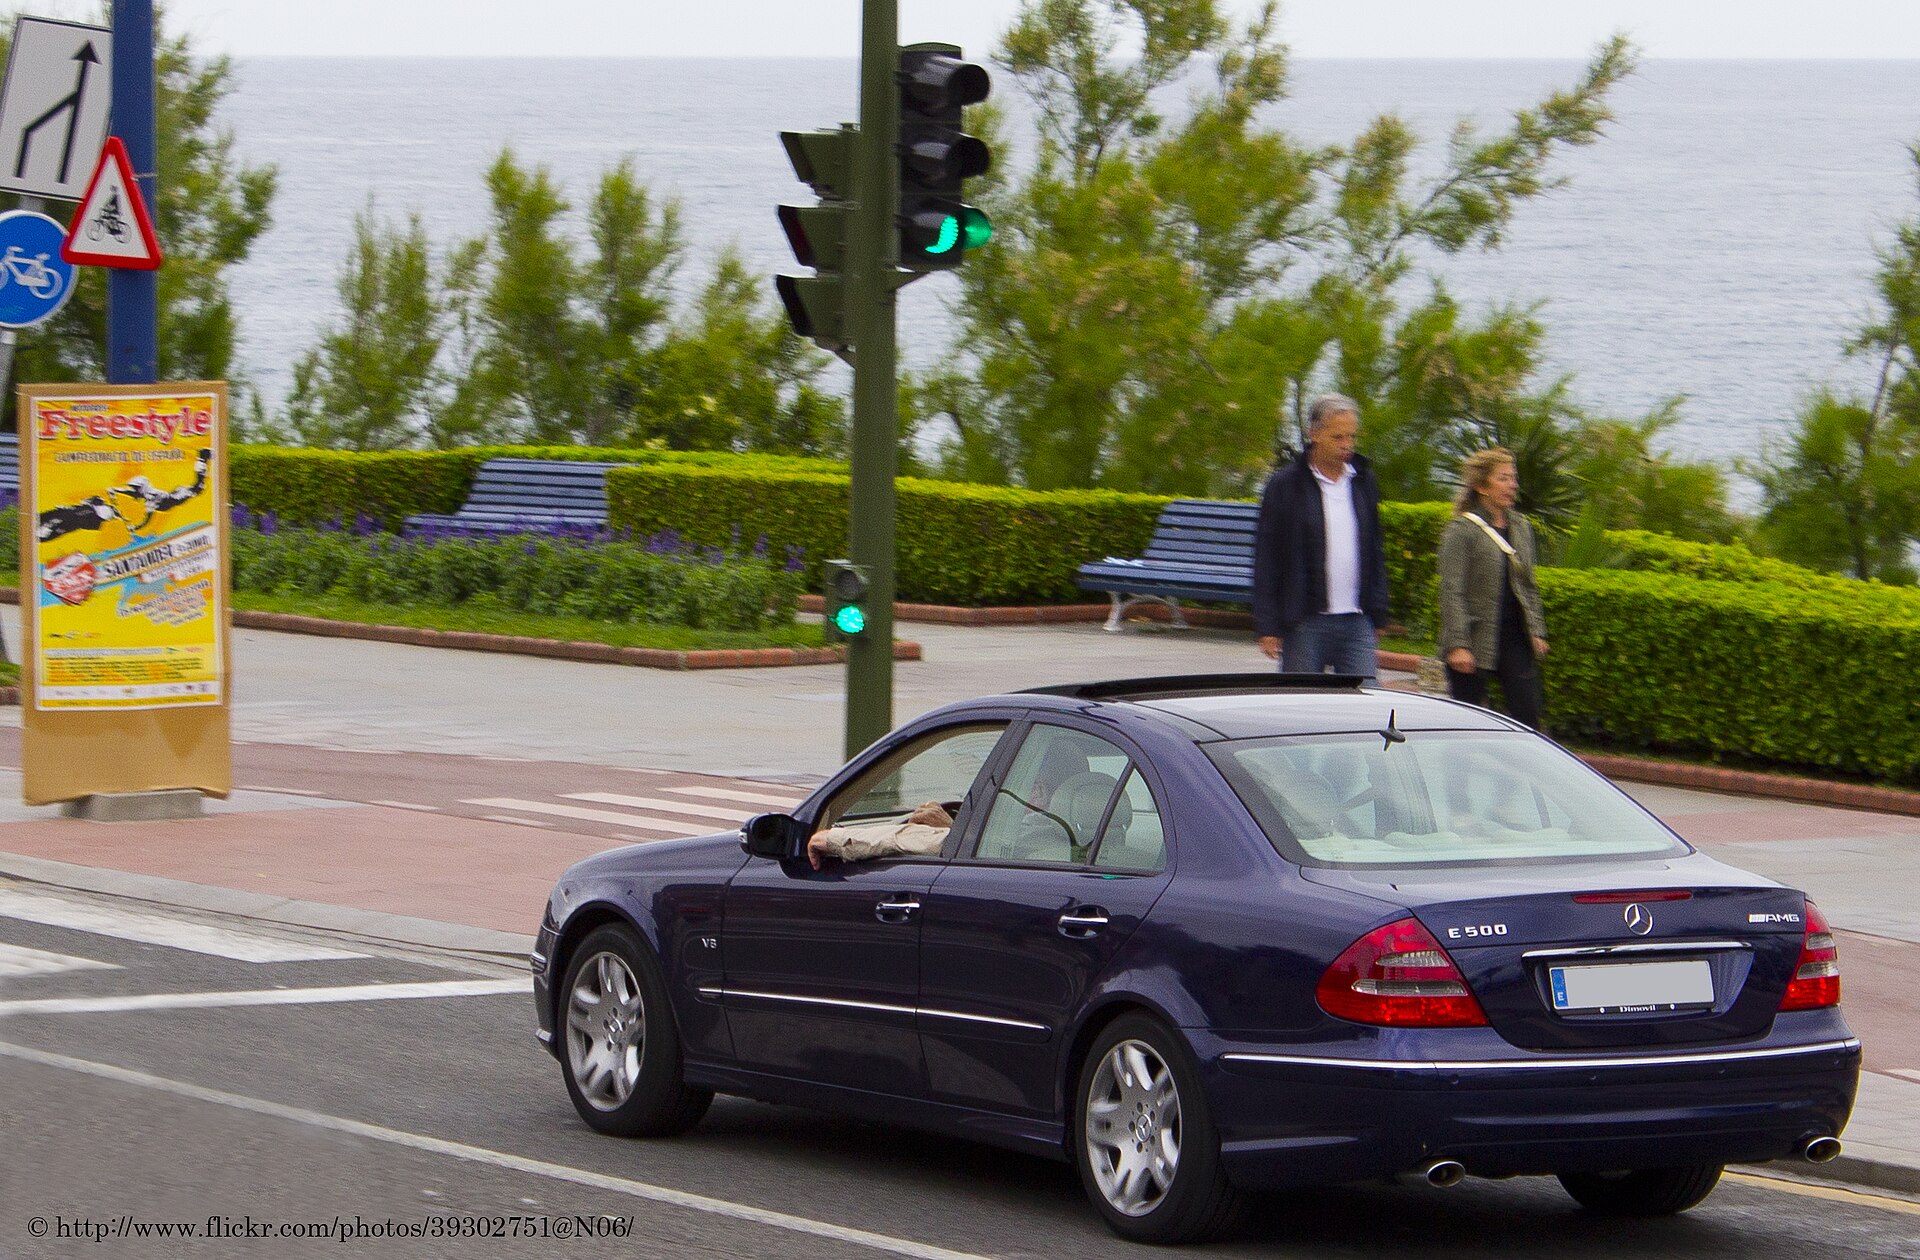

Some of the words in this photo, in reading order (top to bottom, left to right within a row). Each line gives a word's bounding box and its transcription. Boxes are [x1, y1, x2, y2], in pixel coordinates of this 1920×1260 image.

[38, 406, 211, 445] Freestyle
[1764, 913, 1800, 923] AMG
[1448, 928, 1462, 939] E
[1465, 924, 1508, 937] 500
[1619, 1004, 1656, 1013] Dimovil
